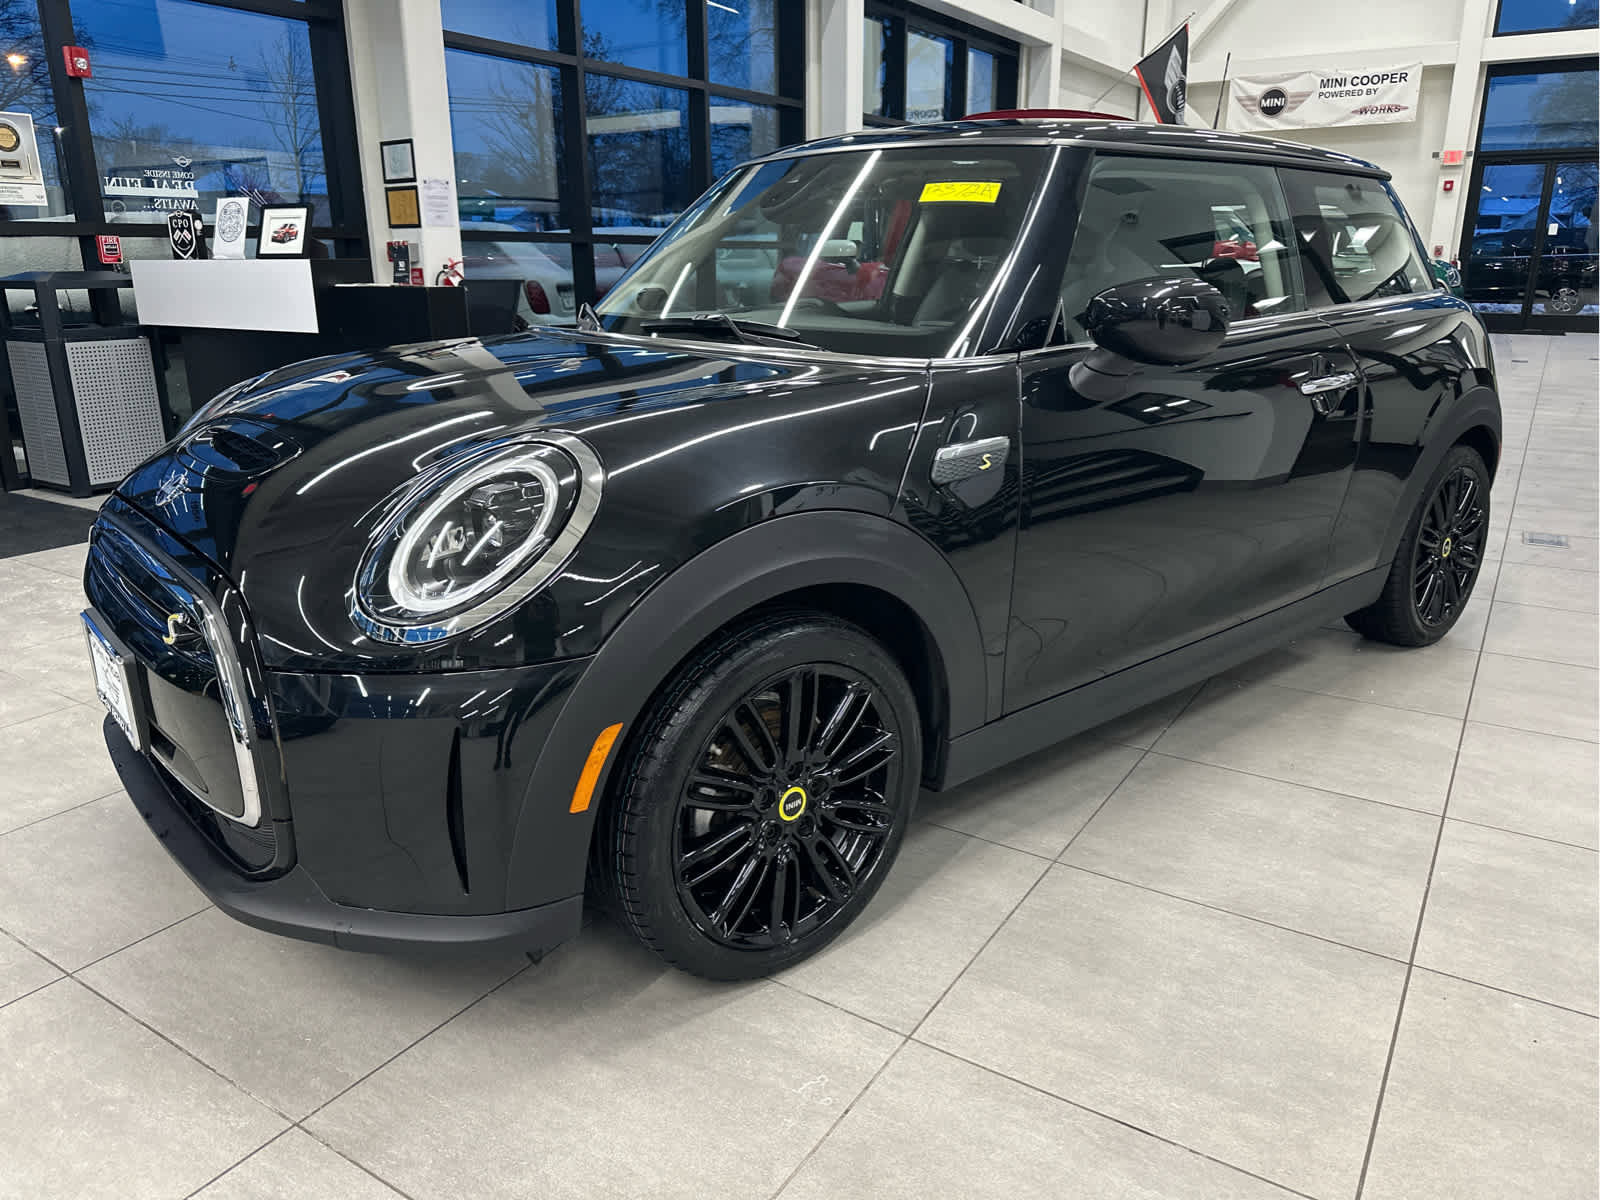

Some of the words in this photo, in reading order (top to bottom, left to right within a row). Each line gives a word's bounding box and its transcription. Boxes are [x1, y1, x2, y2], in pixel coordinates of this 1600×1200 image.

[1319, 77, 1347, 89] MINI
[1350, 72, 1409, 87] COOPER
[1318, 88, 1363, 99] POWERED
[1365, 87, 1379, 96] BY
[1260, 97, 1285, 108] MINI
[172, 218, 189, 228] CPO
[978, 453, 993, 470] S
[785, 798, 802, 811] MINI
